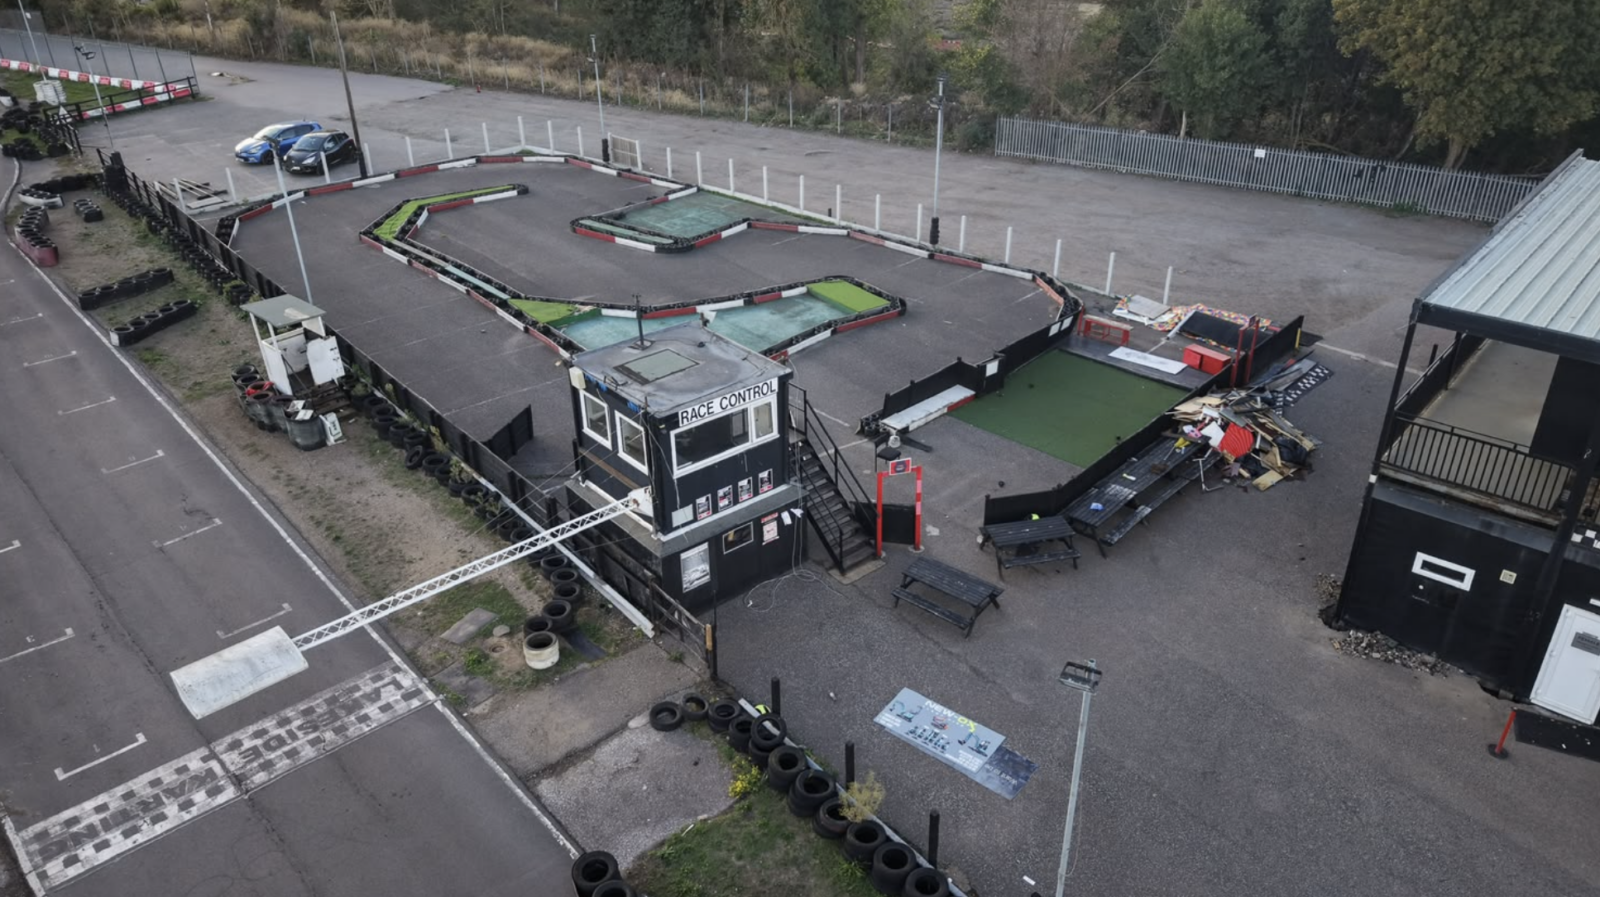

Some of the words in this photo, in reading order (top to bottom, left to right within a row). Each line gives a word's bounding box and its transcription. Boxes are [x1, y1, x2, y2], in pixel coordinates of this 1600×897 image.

[680, 401, 714, 425] RACE
[719, 381, 776, 410] CONTROL
[238, 676, 403, 764] LAKESIDE
